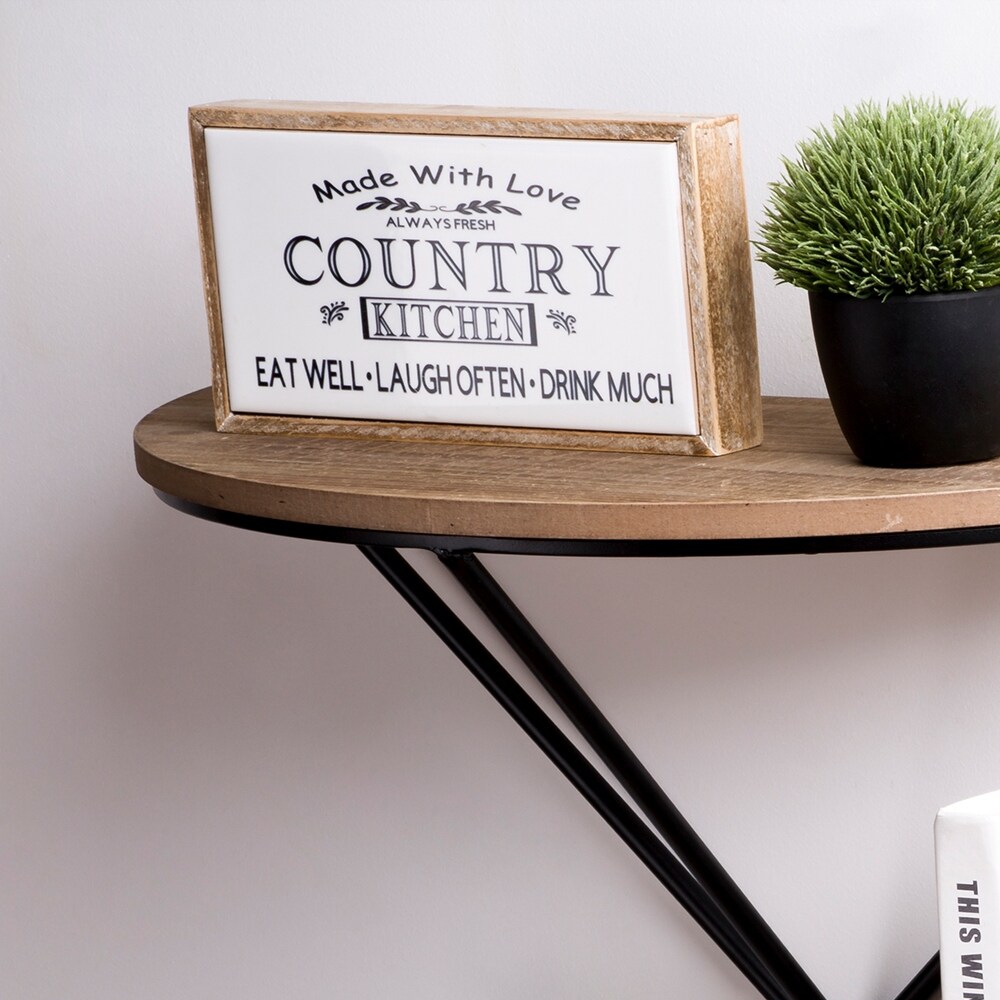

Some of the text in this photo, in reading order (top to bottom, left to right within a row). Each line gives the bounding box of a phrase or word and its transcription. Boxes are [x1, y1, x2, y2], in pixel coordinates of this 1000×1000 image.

[311, 164, 581, 211] Made With Love
[385, 215, 496, 231] ALWAYS FRESH
[283, 234, 621, 297] COUNTRY
[372, 302, 524, 341] KITCHEN
[255, 356, 674, 405] EAT WELL LAUGH OFTEN DRINK MUCH
[956, 880, 982, 943] THIS
